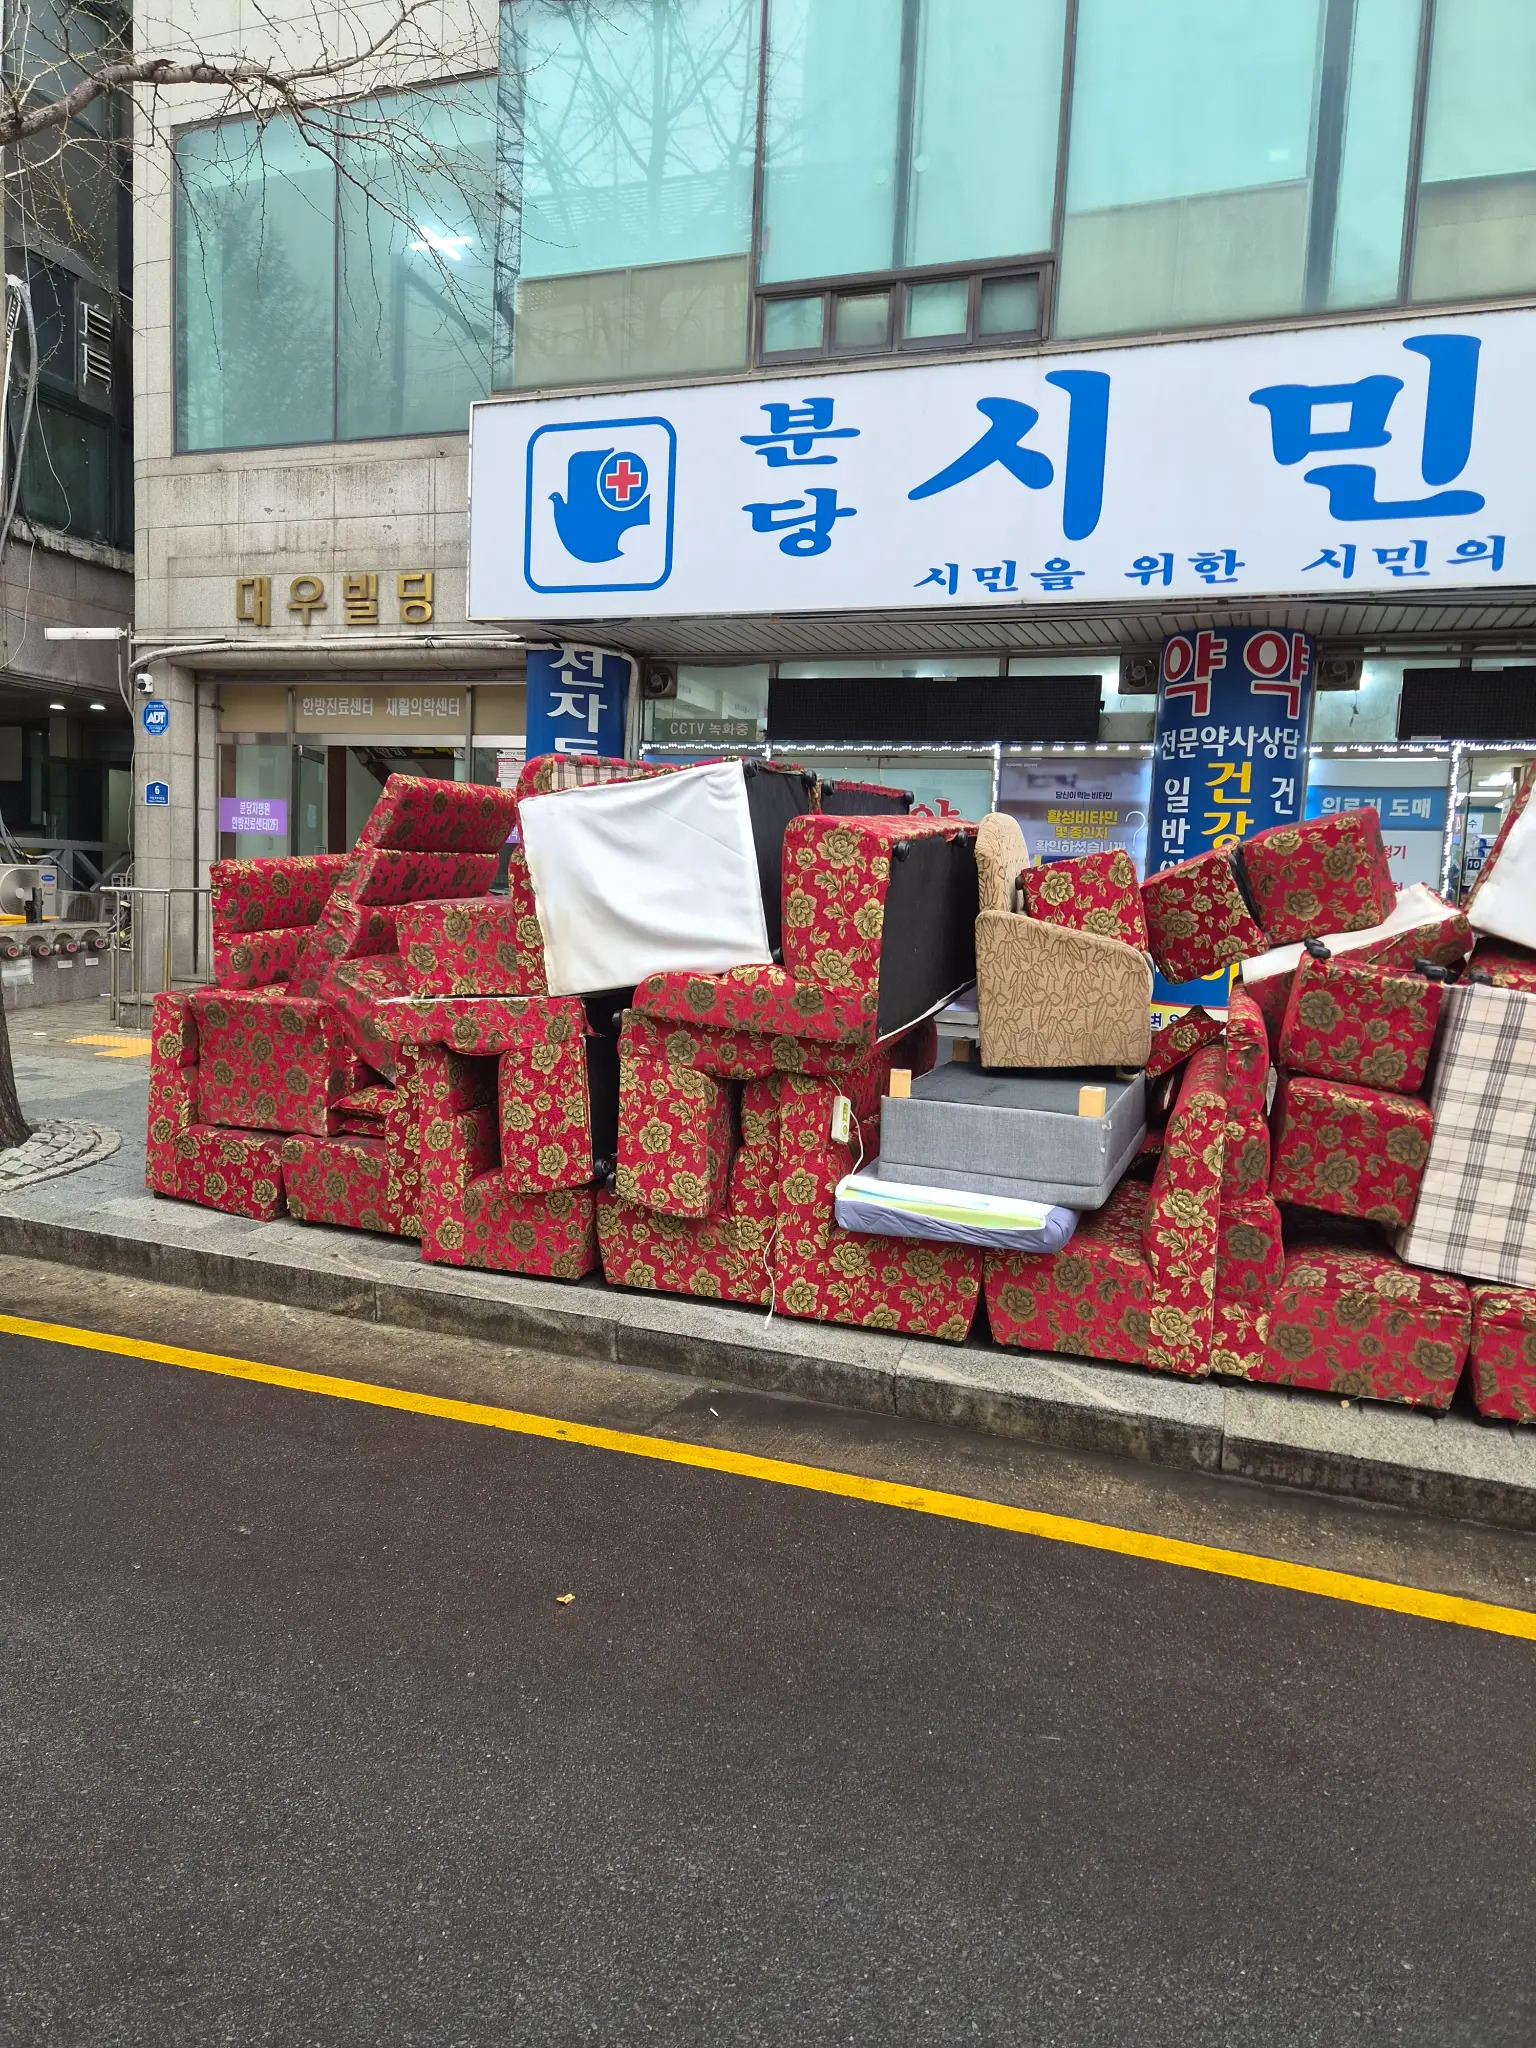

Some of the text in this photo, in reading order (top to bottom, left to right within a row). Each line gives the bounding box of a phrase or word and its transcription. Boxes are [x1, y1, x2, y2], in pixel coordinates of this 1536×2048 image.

[914, 535, 1507, 595] 시민을 위한 시민의
[235, 571, 435, 627] 대우빌딩
[302, 697, 460, 717] 한방진료센터 재활의학센터
[146, 711, 166, 724] ADT
[669, 722, 749, 737] CCTV 녹화중
[154, 785, 161, 795] 6
[1055, 791, 1113, 800] 당신이 먹는 비타민
[1389, 798, 1431, 819] 도매
[1047, 809, 1119, 825] 활성비타민
[1055, 826, 1109, 840] 몇 종인지
[1468, 860, 1480, 870] 10
